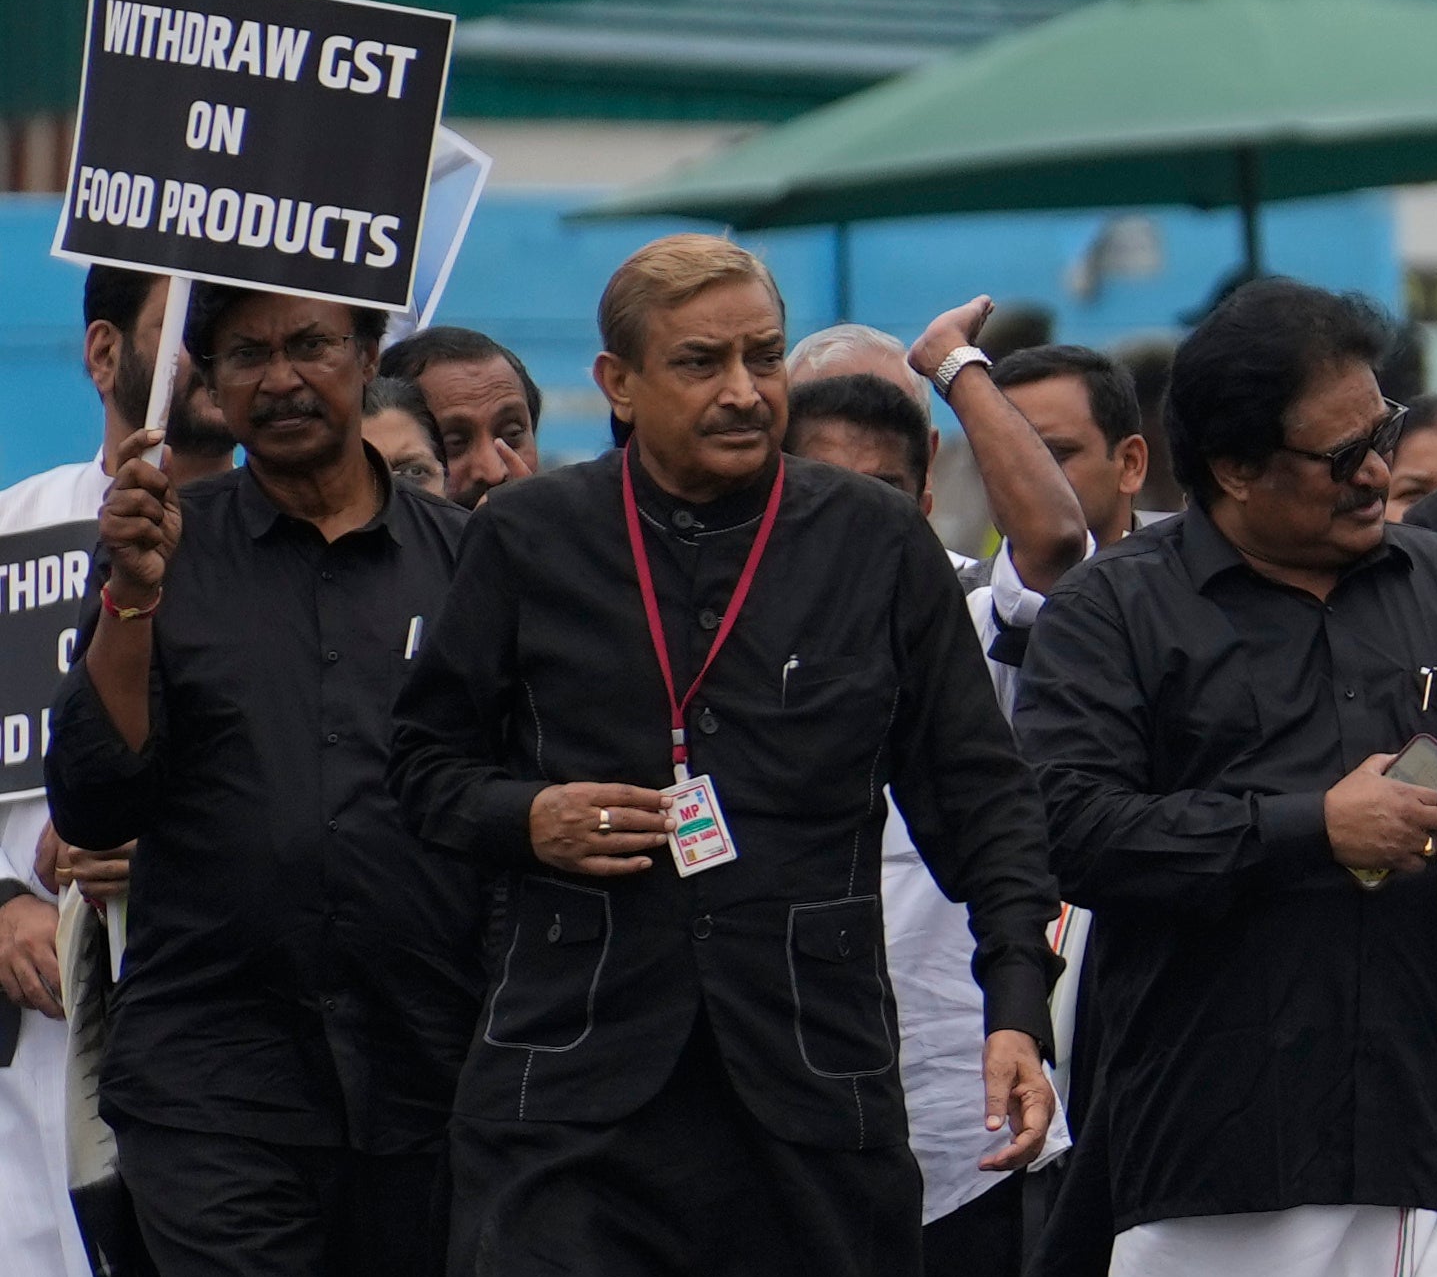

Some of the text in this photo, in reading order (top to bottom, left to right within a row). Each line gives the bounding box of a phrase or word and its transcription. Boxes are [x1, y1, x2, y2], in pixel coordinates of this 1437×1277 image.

[103, 0, 418, 99] WITHDRAW GST
[185, 100, 246, 156] ON
[74, 165, 401, 269] FOOD PRODUCTS
[679, 804, 700, 821] MP
